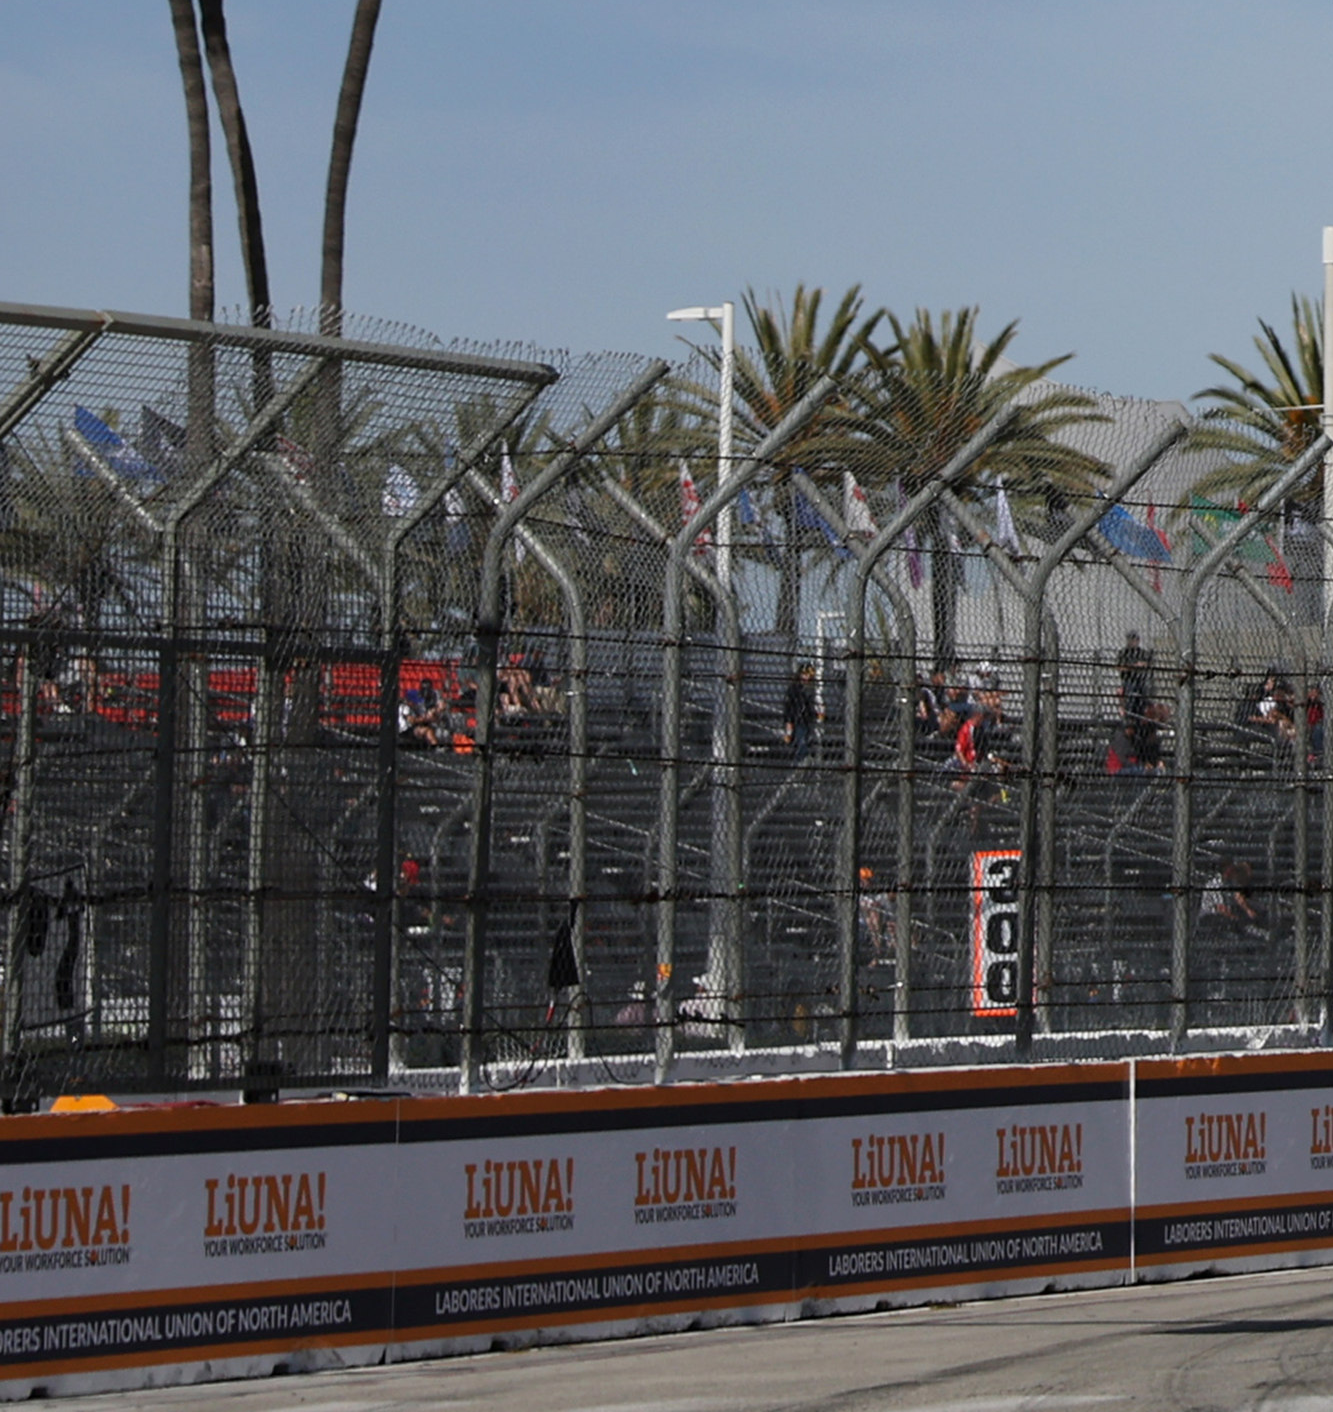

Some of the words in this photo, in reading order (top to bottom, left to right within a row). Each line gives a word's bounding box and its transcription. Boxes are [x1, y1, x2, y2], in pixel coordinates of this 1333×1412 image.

[987, 859, 1020, 1003] 300
[852, 1132, 945, 1190] LiUNA!
[996, 1123, 1082, 1178] LiUNA!
[1185, 1112, 1266, 1164] LiUNA!
[464, 1157, 574, 1220] LiUNA!
[634, 1146, 737, 1207] LiUNA!
[852, 1191, 869, 1207] YOUR
[0, 1183, 131, 1252] LiUNA!
[204, 1171, 327, 1238] LiUNA!
[464, 1221, 484, 1238] YOUR
[487, 1217, 535, 1237] WORKFORCE
[536, 1214, 573, 1233] SOLUTION
[634, 1208, 653, 1224] YOUR
[656, 1205, 700, 1222] WORKFORCE
[701, 1202, 736, 1219] SOLUTION
[1164, 1221, 1212, 1244] LABORERS
[1214, 1215, 1285, 1239] INTERNATIONAL
[1288, 1213, 1317, 1233] UNION
[1319, 1211, 1331, 1230] OF
[25, 1250, 82, 1272] WORKFORCE
[204, 1239, 227, 1258] YOUR
[230, 1236, 282, 1256] WORKFORCE
[284, 1233, 325, 1252] SOLUTION
[829, 1251, 883, 1276] LABORERS
[886, 1243, 968, 1271] INTERNATIONAL
[970, 1240, 1004, 1263] UNION
[1007, 1239, 1020, 1259] OF
[1022, 1236, 1057, 1258] NORTH
[1058, 1232, 1102, 1254] AMERICA
[436, 1286, 500, 1314] LABORERS
[503, 1277, 600, 1308] INTERNATIONAL
[602, 1273, 642, 1298] UNION
[646, 1272, 661, 1294] OF
[664, 1268, 704, 1292] NORTH
[706, 1263, 758, 1288] AMERICA
[43, 1316, 162, 1348] INTERNATIONAL
[165, 1311, 214, 1338] UNION
[217, 1308, 235, 1333] OF
[239, 1304, 288, 1331] NORTH
[290, 1299, 351, 1327] AMERICA
